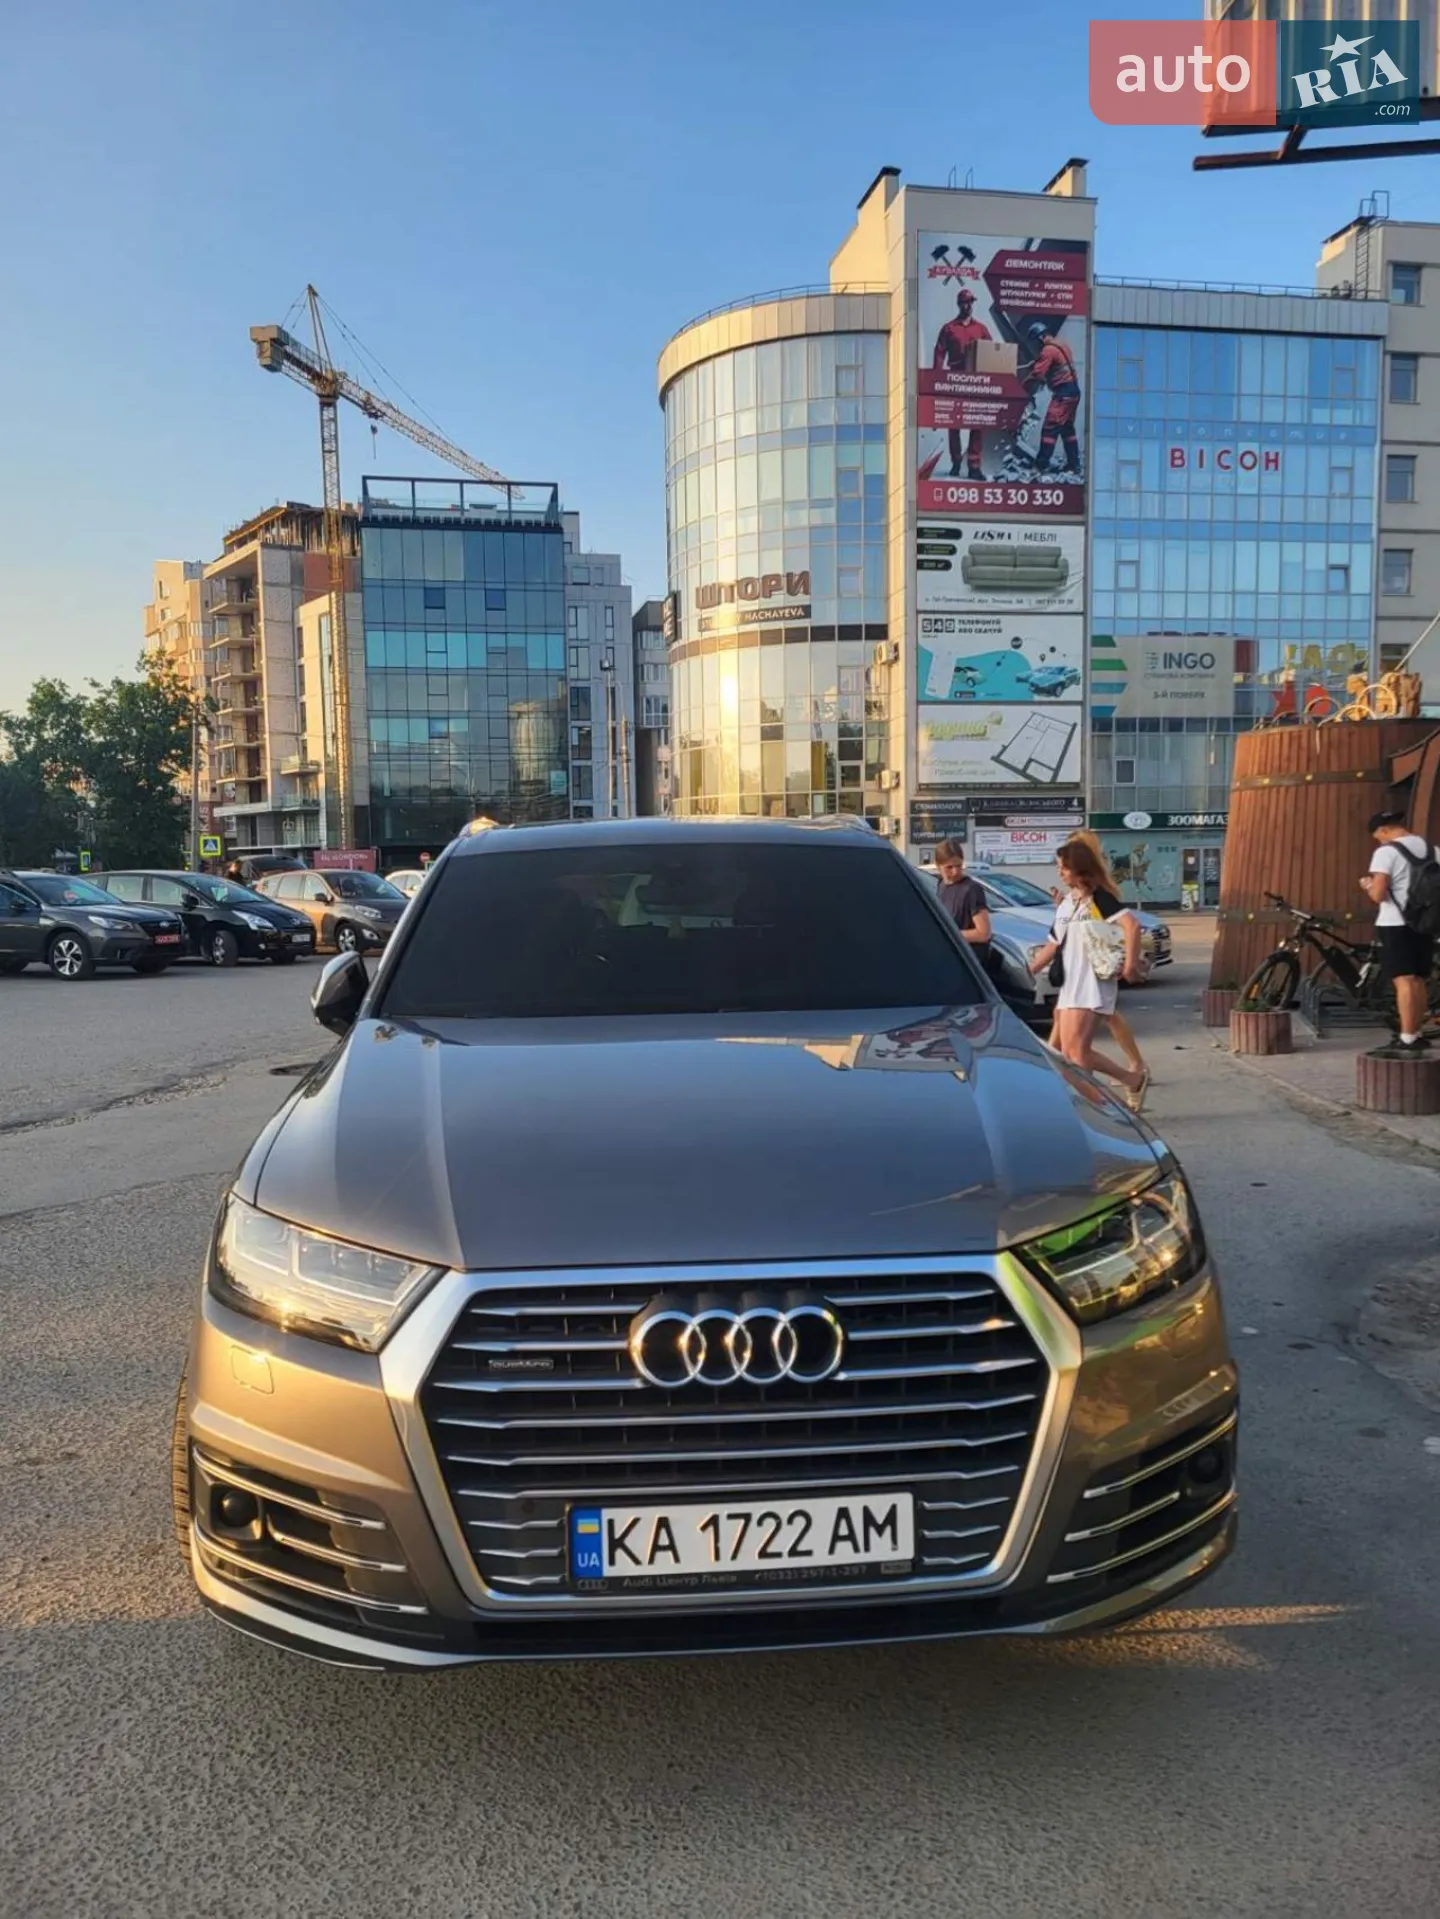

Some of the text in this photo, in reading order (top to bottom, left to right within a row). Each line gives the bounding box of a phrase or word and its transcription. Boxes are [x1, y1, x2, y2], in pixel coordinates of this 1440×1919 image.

[947, 373, 991, 384] ПОСЛУГИ
[947, 487, 1064, 506] 098 53 30 330
[1024, 532, 1057, 542] МЕБЛІ
[695, 570, 811, 609] ШТОРИ
[1163, 651, 1216, 670] INGO
[606, 1502, 899, 1567] KA 1722 AM
[577, 1552, 600, 1568] UA
